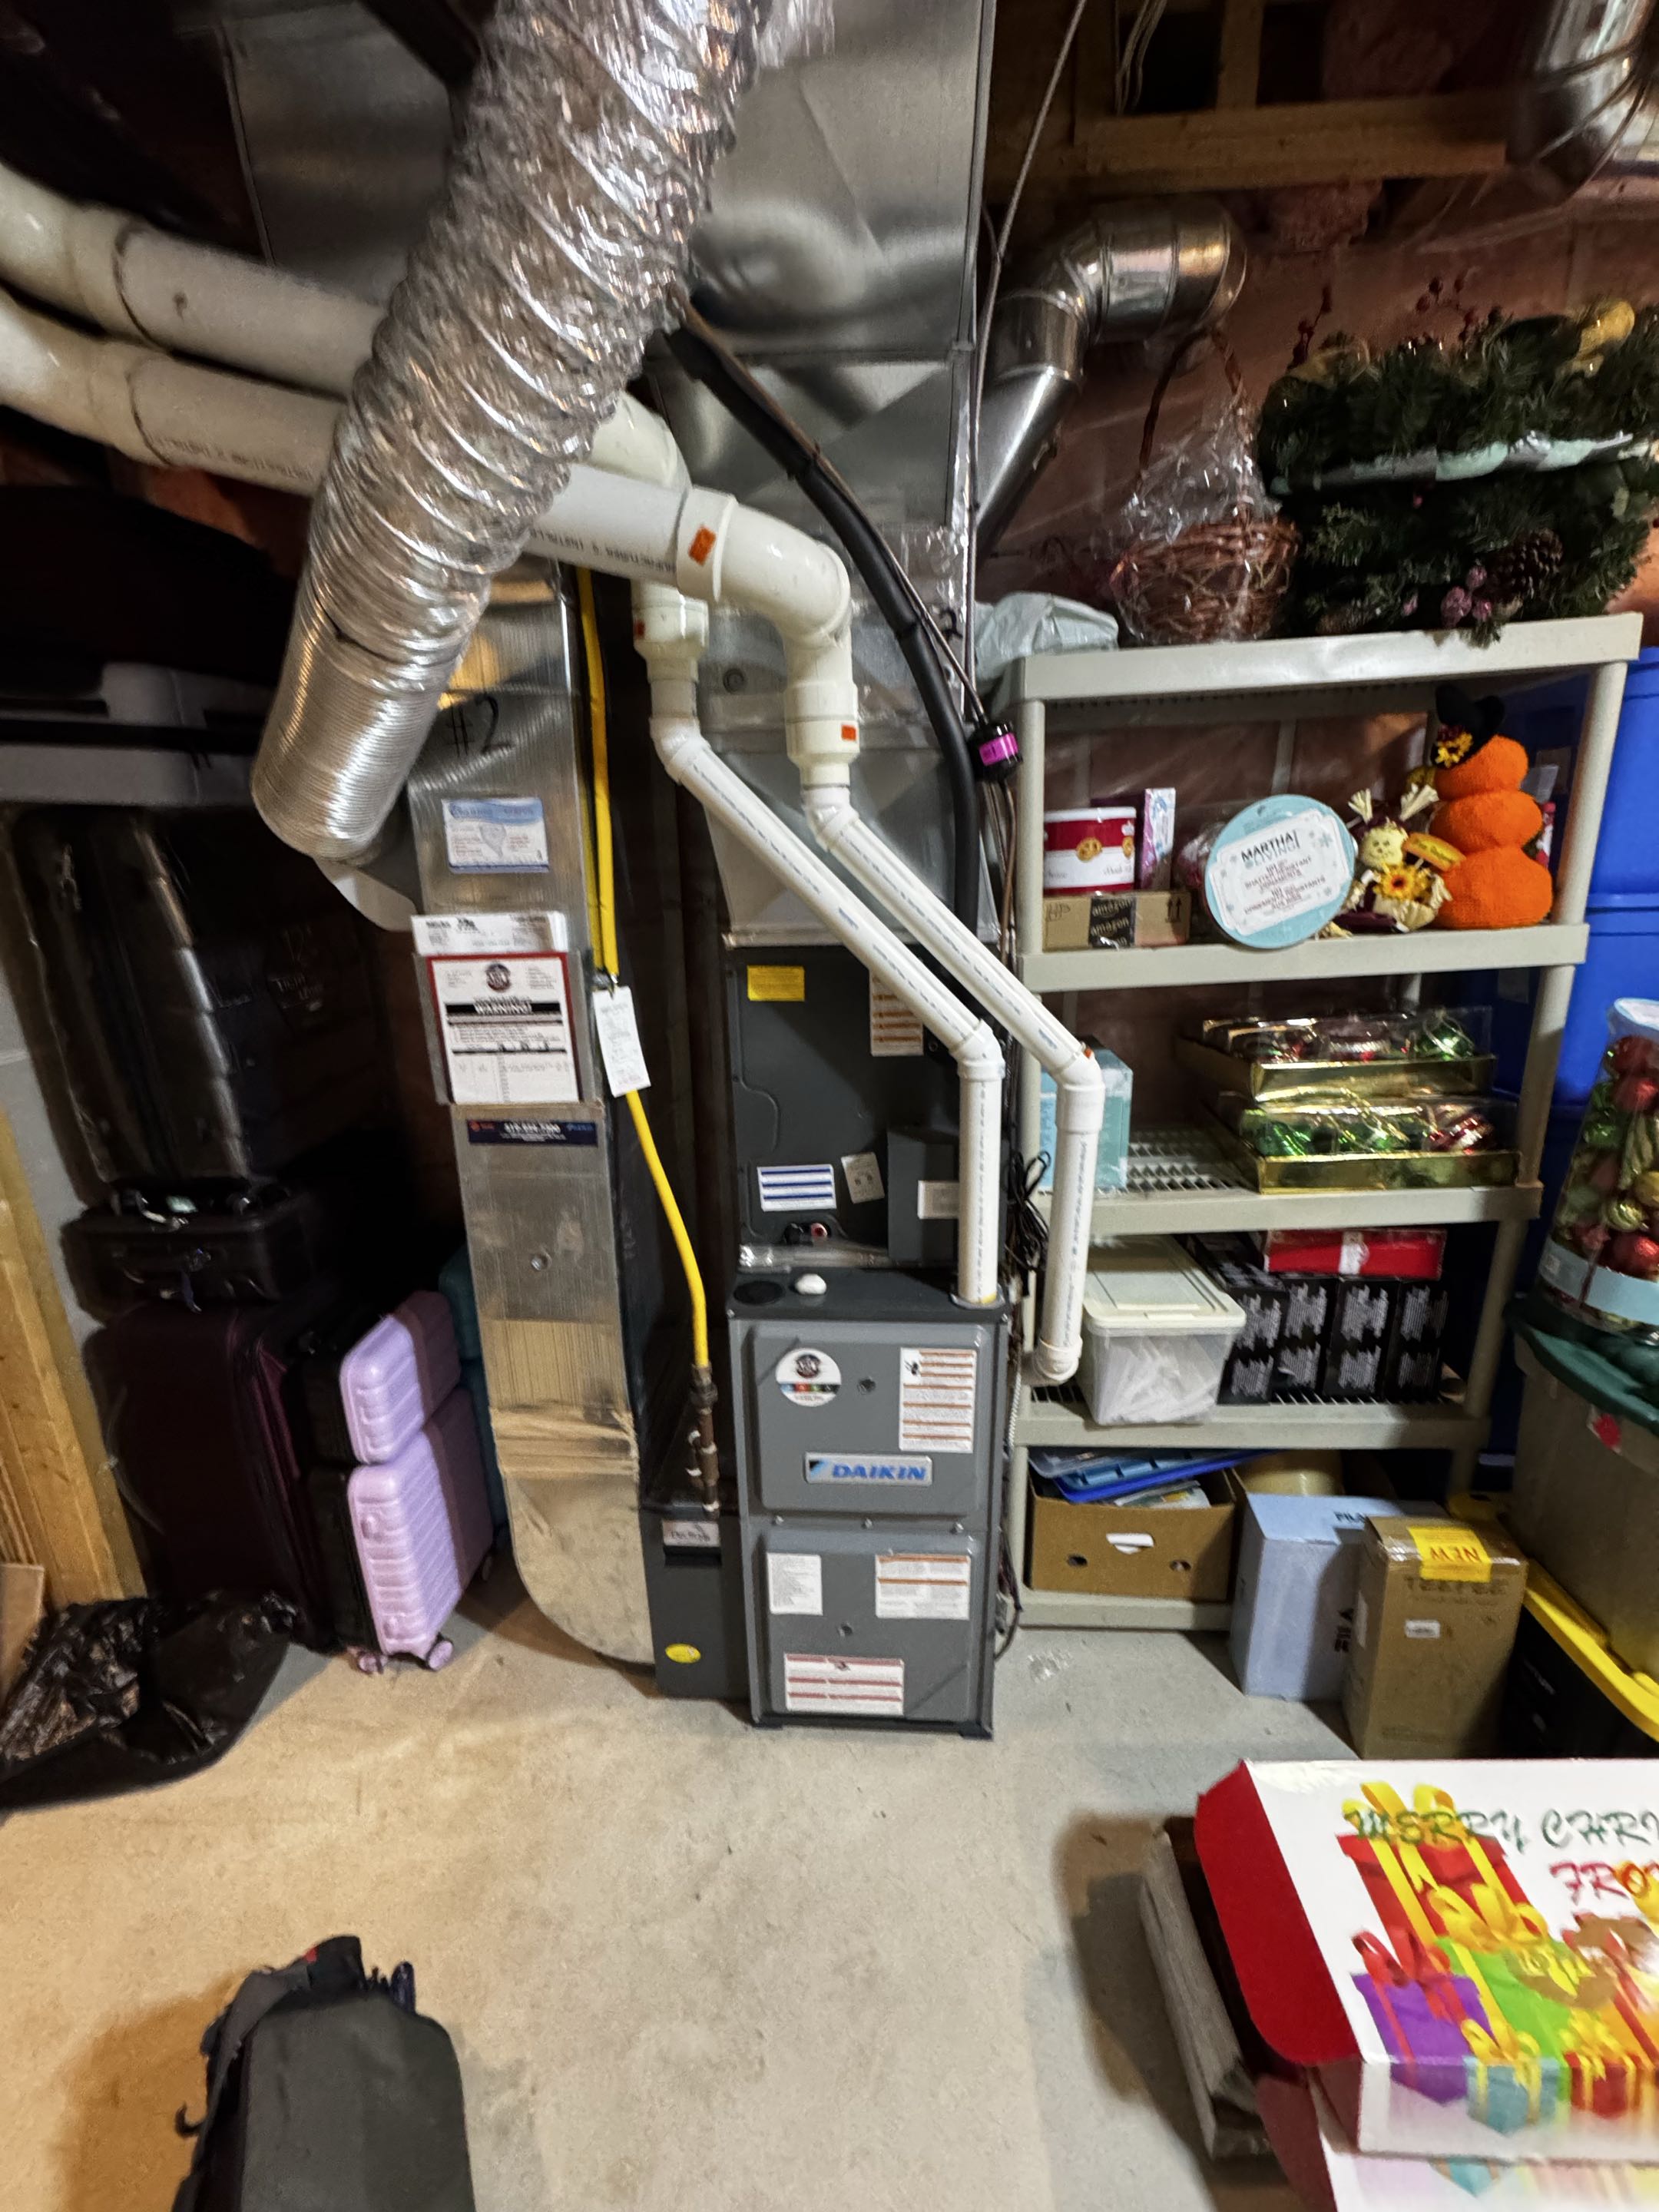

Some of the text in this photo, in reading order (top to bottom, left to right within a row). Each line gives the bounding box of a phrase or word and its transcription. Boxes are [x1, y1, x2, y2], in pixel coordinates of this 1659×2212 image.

[1091, 898, 1131, 917] amazon
[1090, 916, 1130, 936] amazon
[833, 1463, 927, 1481] DAIKIN
